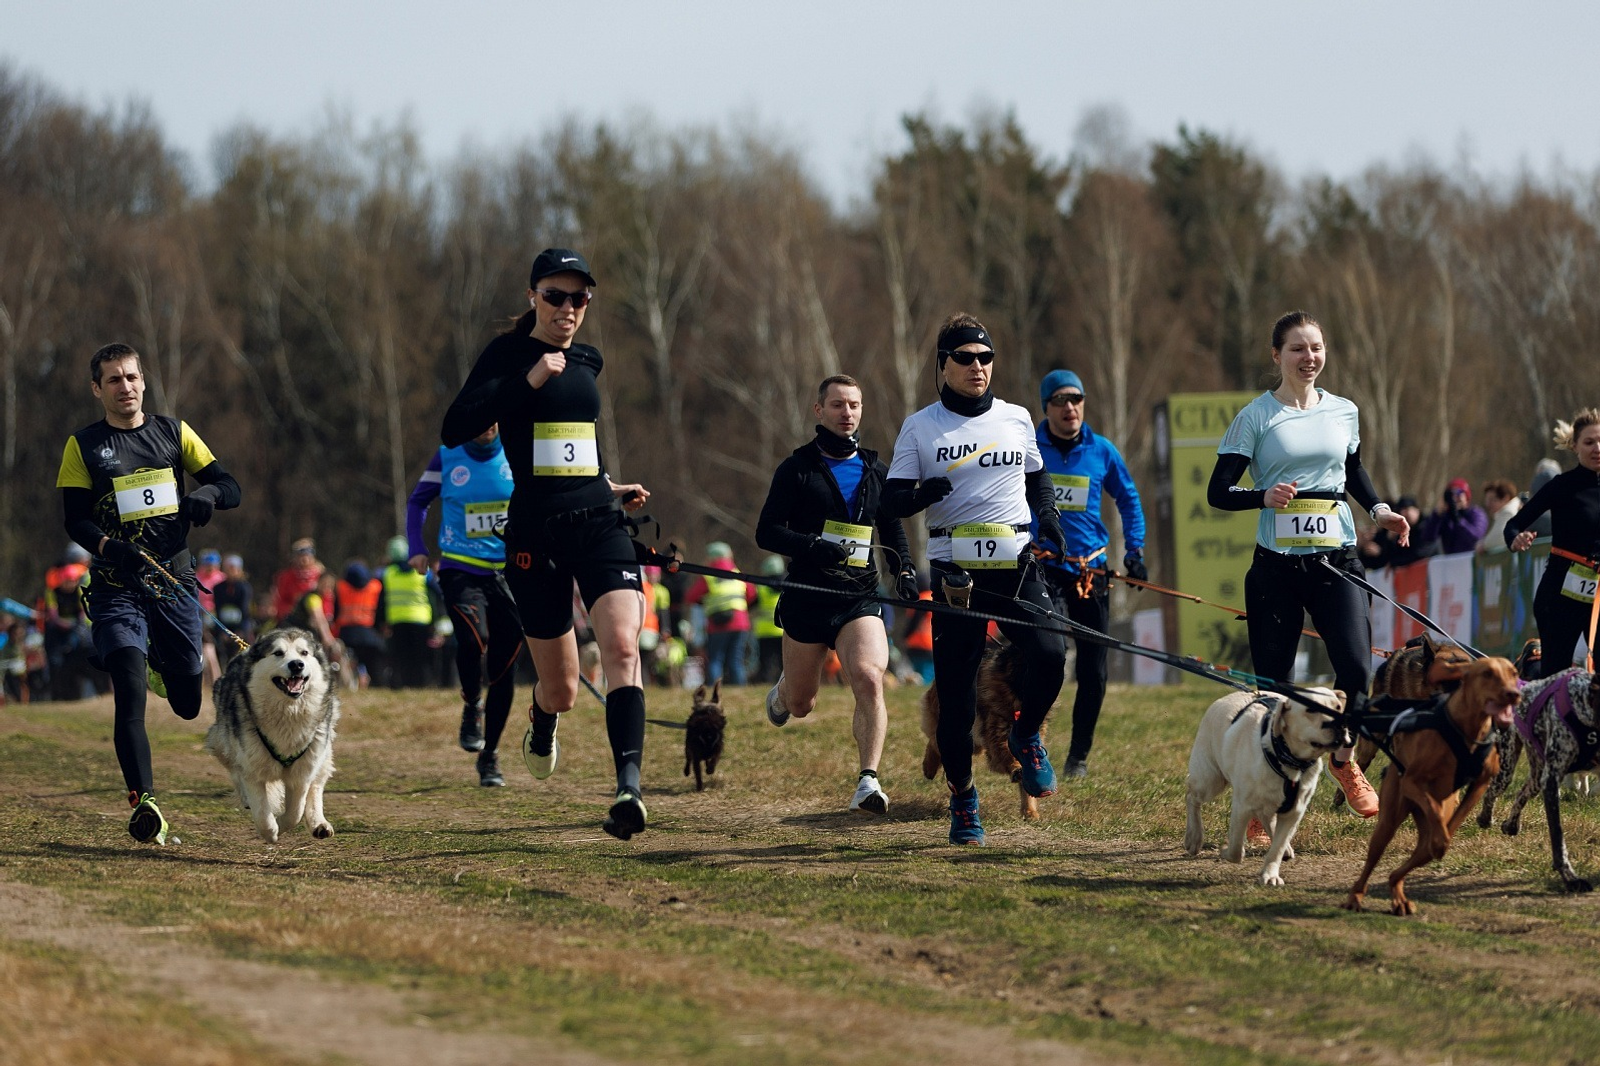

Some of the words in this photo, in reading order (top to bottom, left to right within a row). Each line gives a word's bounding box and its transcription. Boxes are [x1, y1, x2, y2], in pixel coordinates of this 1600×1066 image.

[1175, 404, 1239, 432] СТА
[564, 442, 575, 462] 3
[936, 443, 977, 462] RUN
[978, 451, 1023, 468] CLUB
[143, 489, 155, 506] 8
[1055, 488, 1073, 502] 24
[477, 514, 504, 529] 115
[1291, 516, 1327, 534] 140
[973, 540, 997, 558] 19
